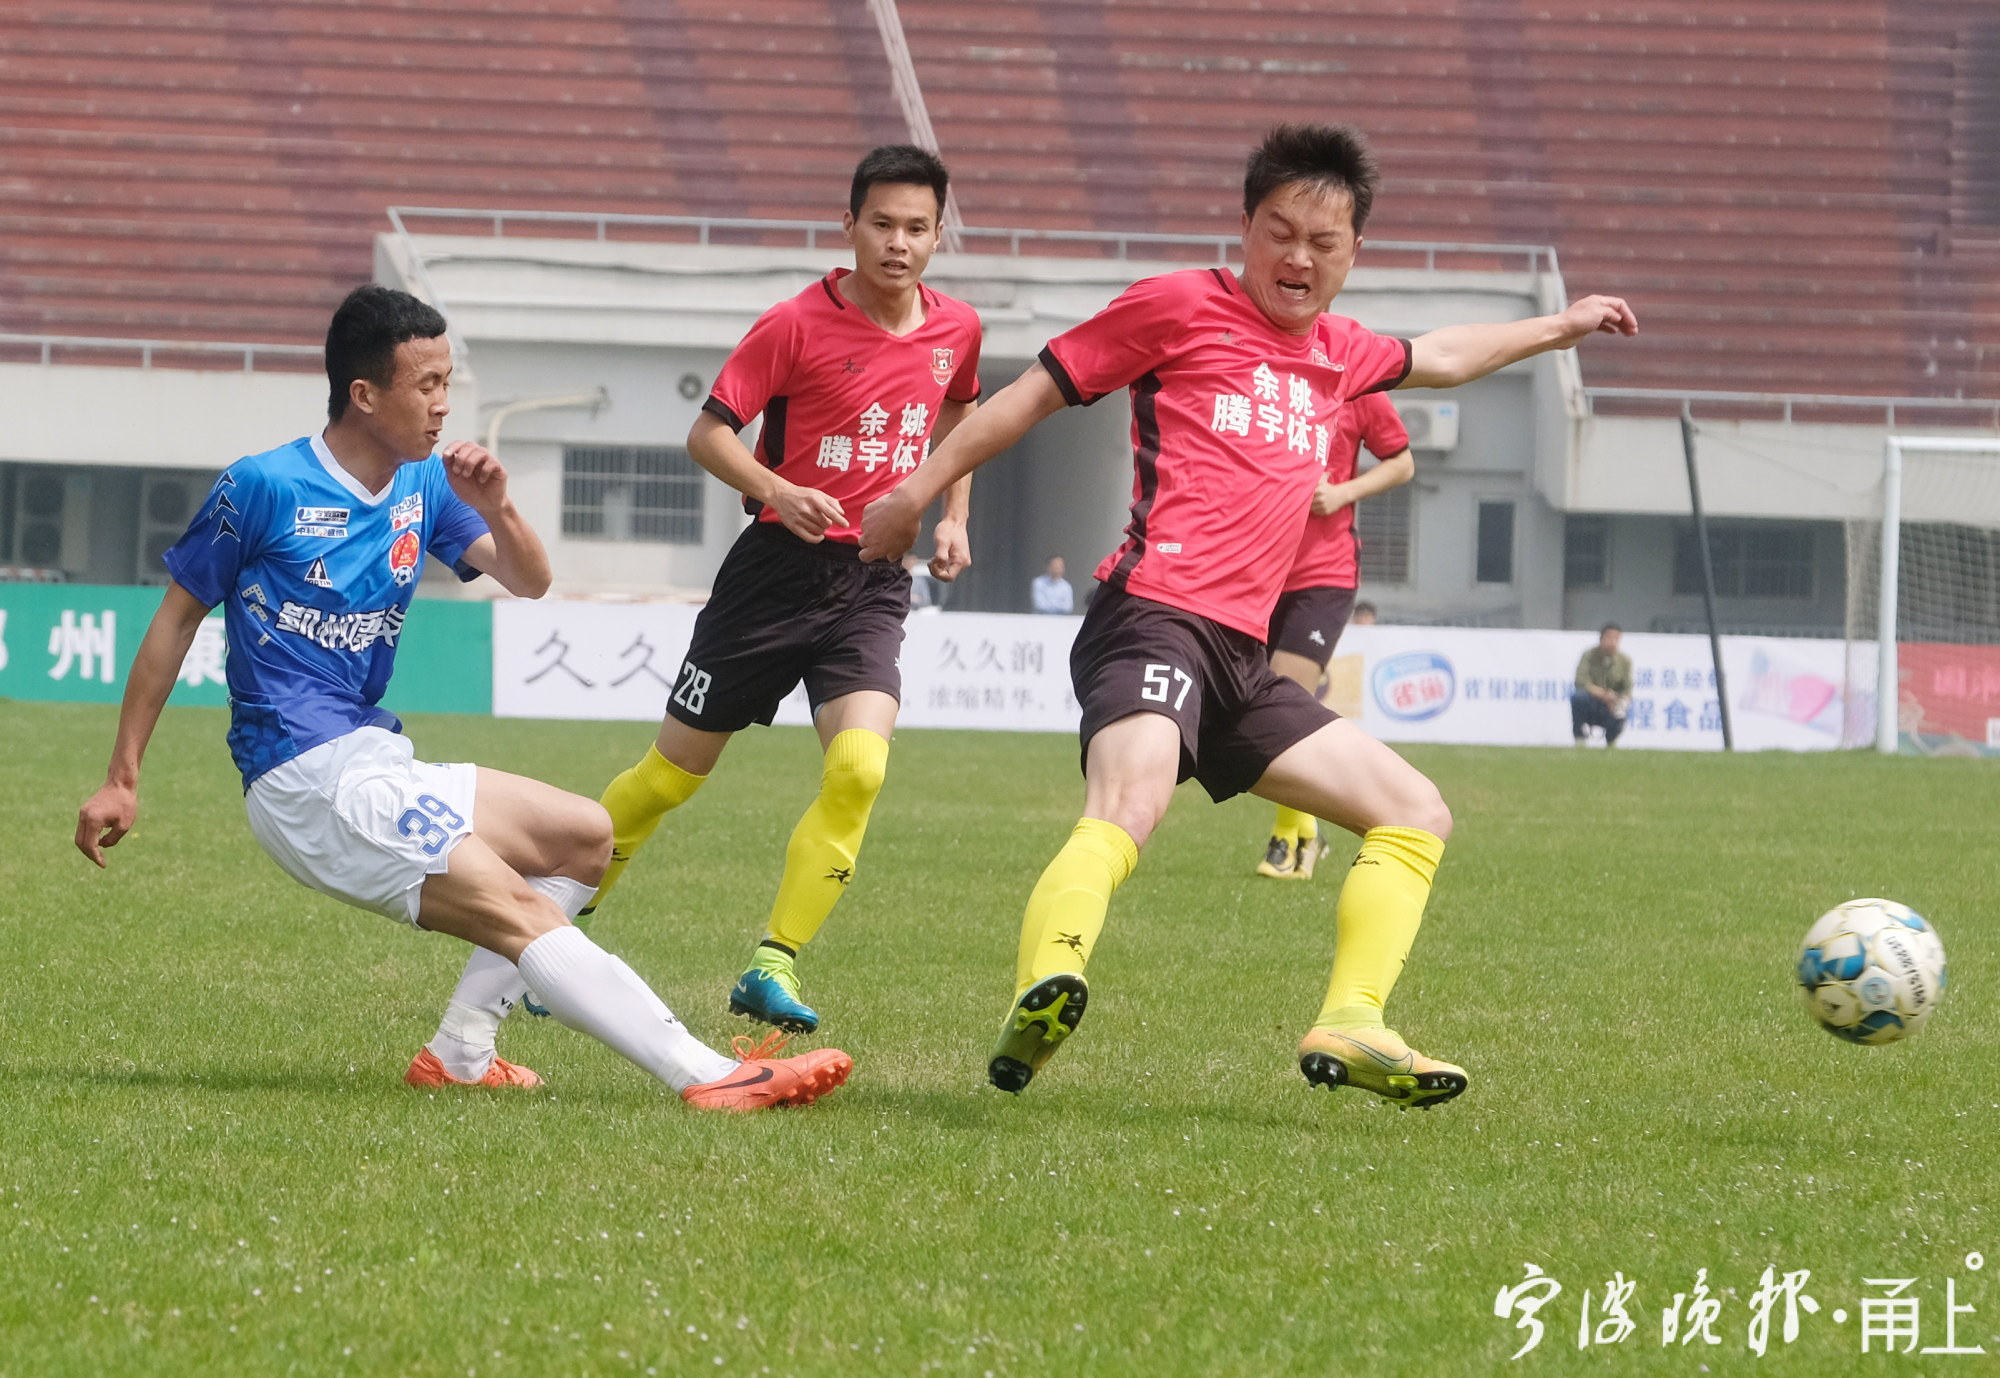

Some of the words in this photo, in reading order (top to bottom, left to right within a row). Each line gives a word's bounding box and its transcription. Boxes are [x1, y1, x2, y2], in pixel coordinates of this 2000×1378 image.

[1252, 361, 1316, 417] 余姚
[857, 402, 929, 437] 余姚
[1211, 393, 1328, 466] 腾宇体育
[673, 660, 713, 716] 28
[1141, 663, 1194, 712] 57
[396, 793, 466, 858] 39
